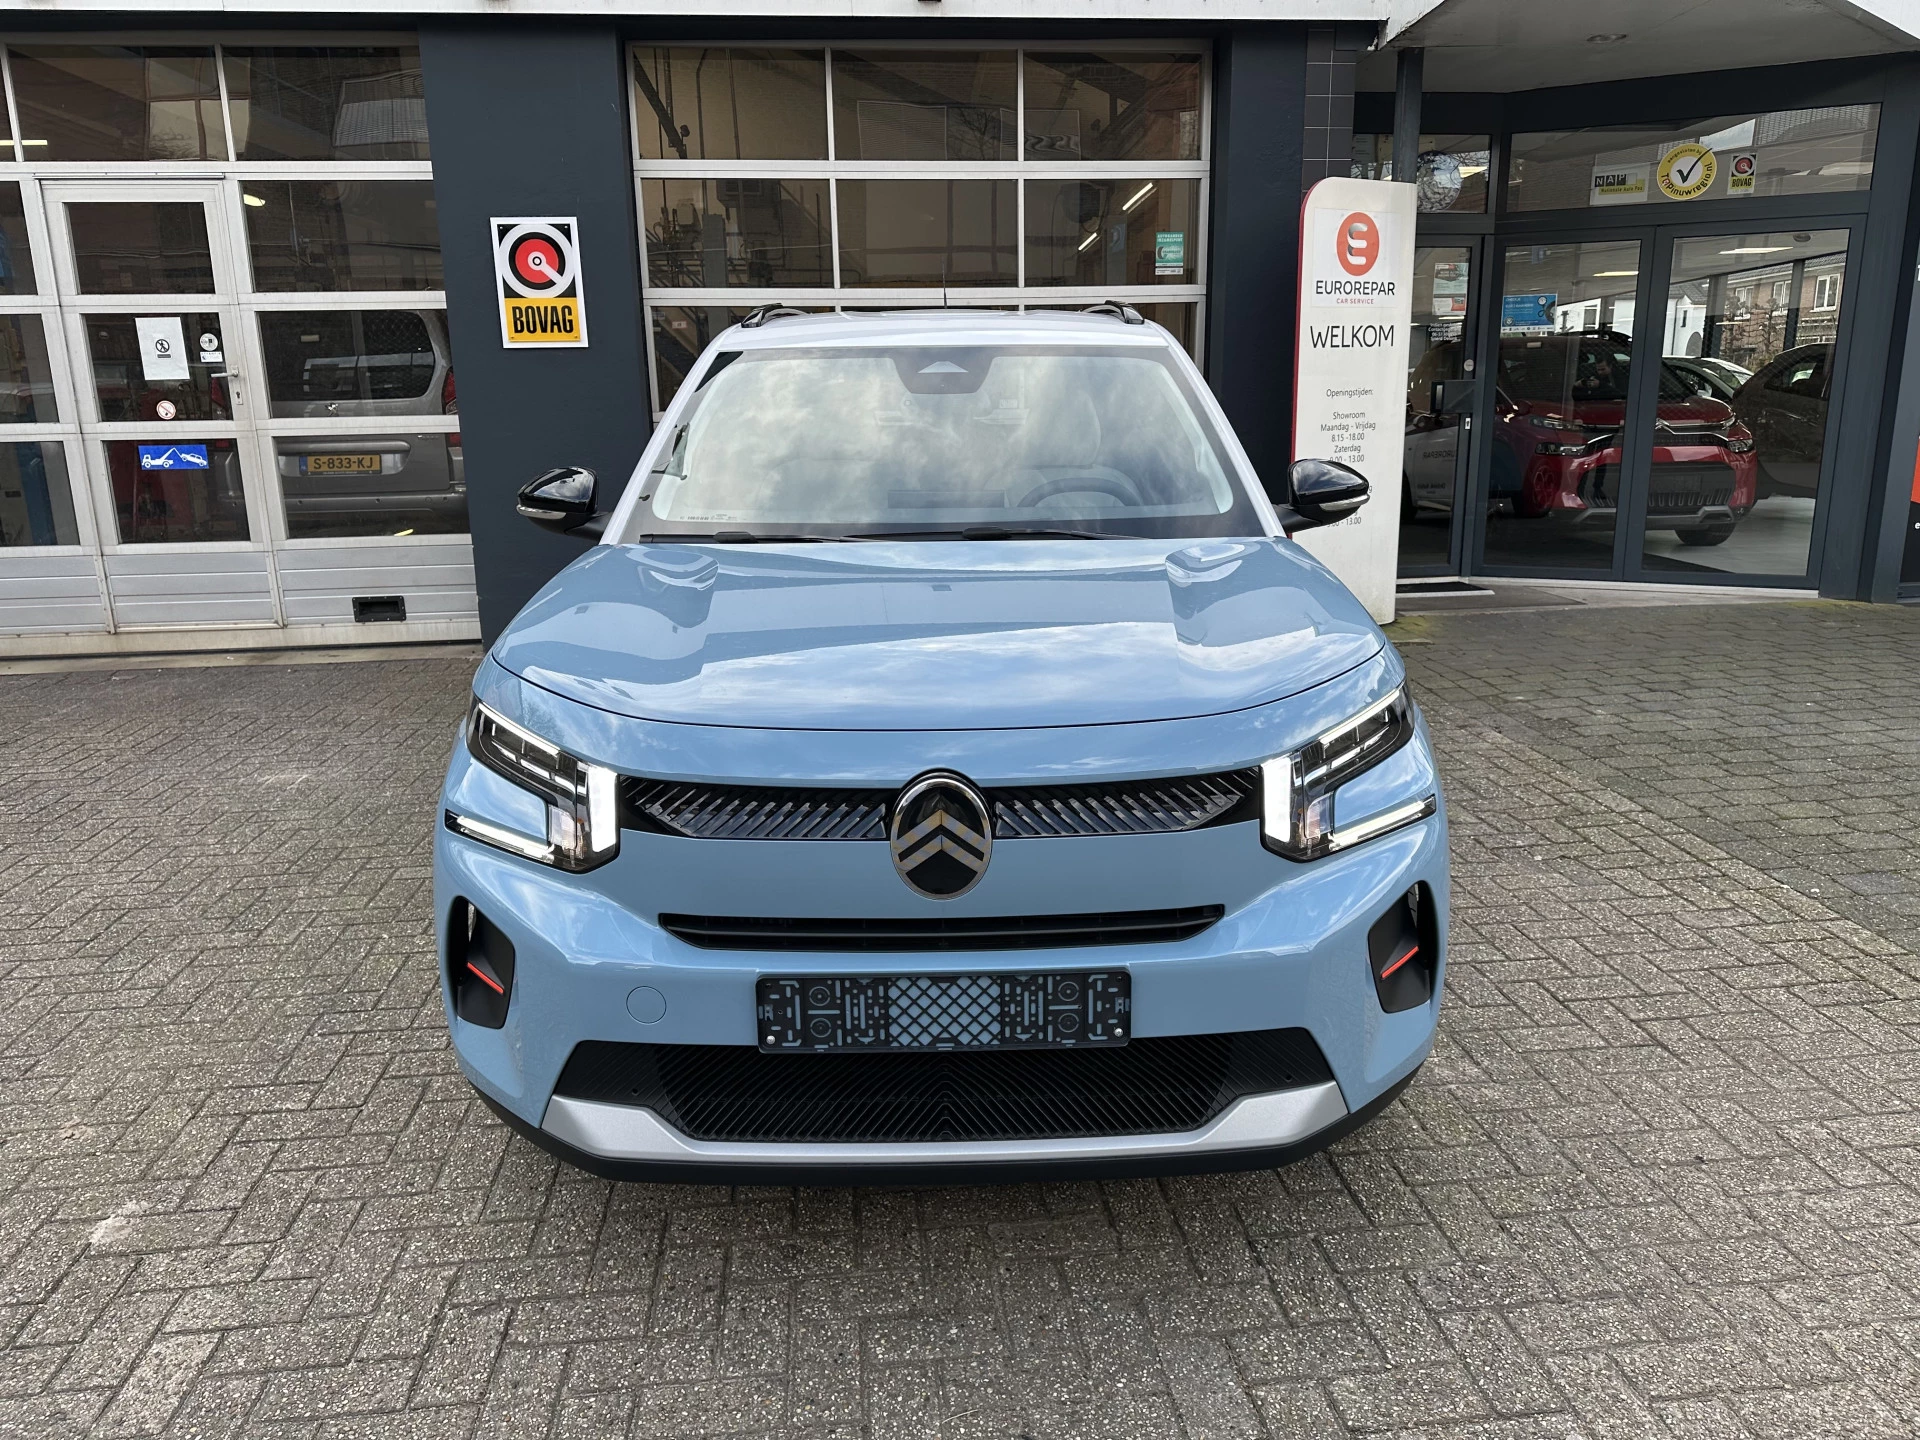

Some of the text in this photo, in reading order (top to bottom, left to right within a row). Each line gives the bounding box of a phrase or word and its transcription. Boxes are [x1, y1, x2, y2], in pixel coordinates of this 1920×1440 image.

[1731, 178, 1752, 187] BOVAG
[1316, 280, 1395, 295] EUROREPAR
[512, 305, 574, 333] BOVAG
[1310, 325, 1394, 348] WELKOM
[1326, 388, 1373, 399] Openingstijden:
[1333, 412, 1365, 420] Showroom
[1320, 422, 1349, 432] Maandag
[1355, 421, 1376, 431] Vrijdag
[1331, 433, 1344, 442] 8.15
[1334, 444, 1361, 453] Zaterdag
[314, 457, 373, 469] S-833-KJ
[1349, 454, 1364, 463] 13.00
[1346, 517, 1361, 525] 13.00
